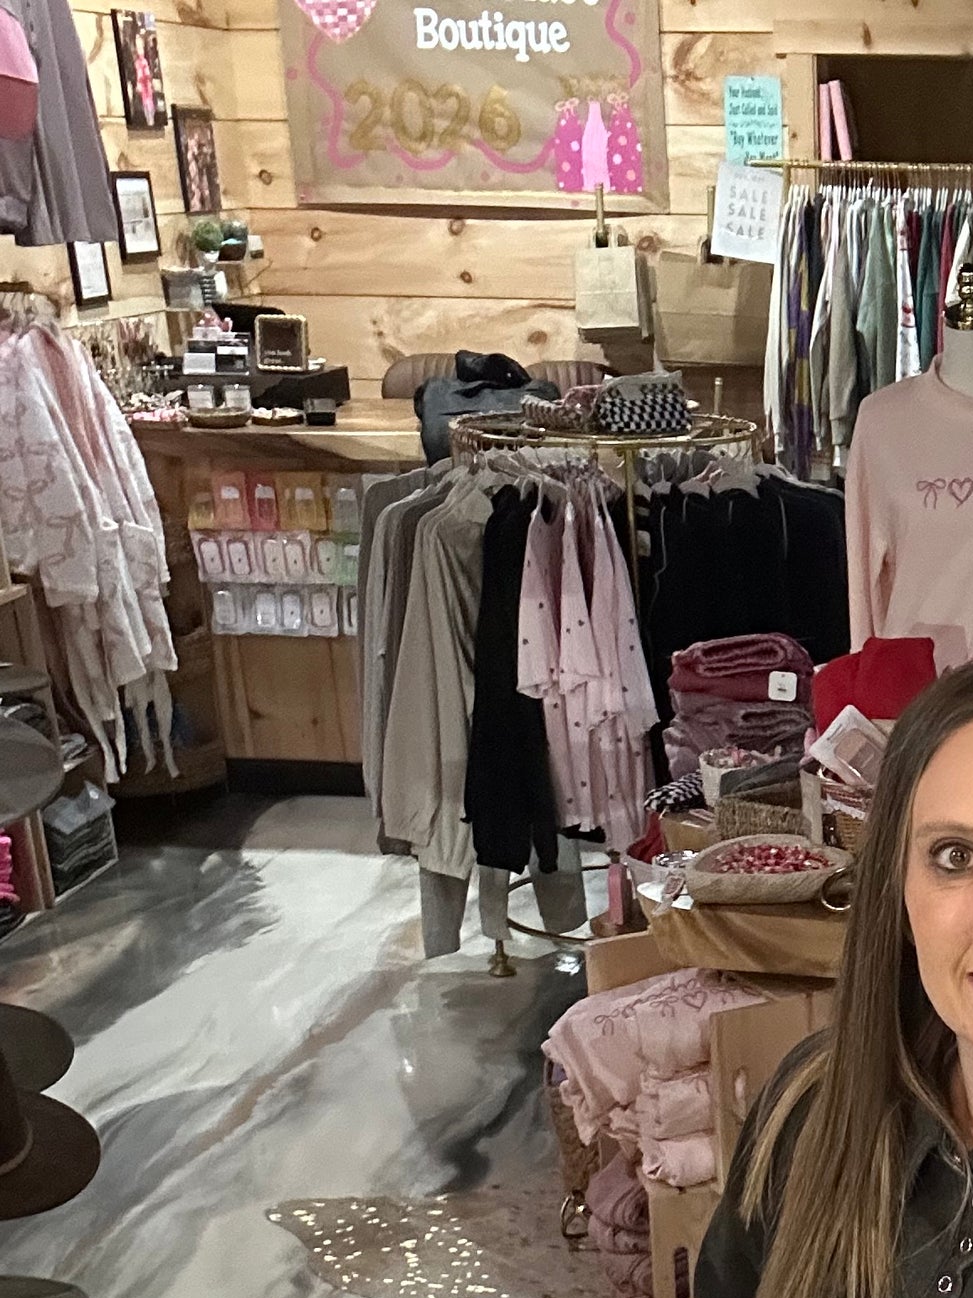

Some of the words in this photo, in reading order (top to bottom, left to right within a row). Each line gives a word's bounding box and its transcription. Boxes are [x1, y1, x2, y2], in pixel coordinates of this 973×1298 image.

[413, 7, 571, 63] Boutique
[344, 78, 522, 156] 2026
[730, 185, 769, 205] SALE
[728, 203, 767, 222] SALE
[726, 221, 765, 241] SALE
